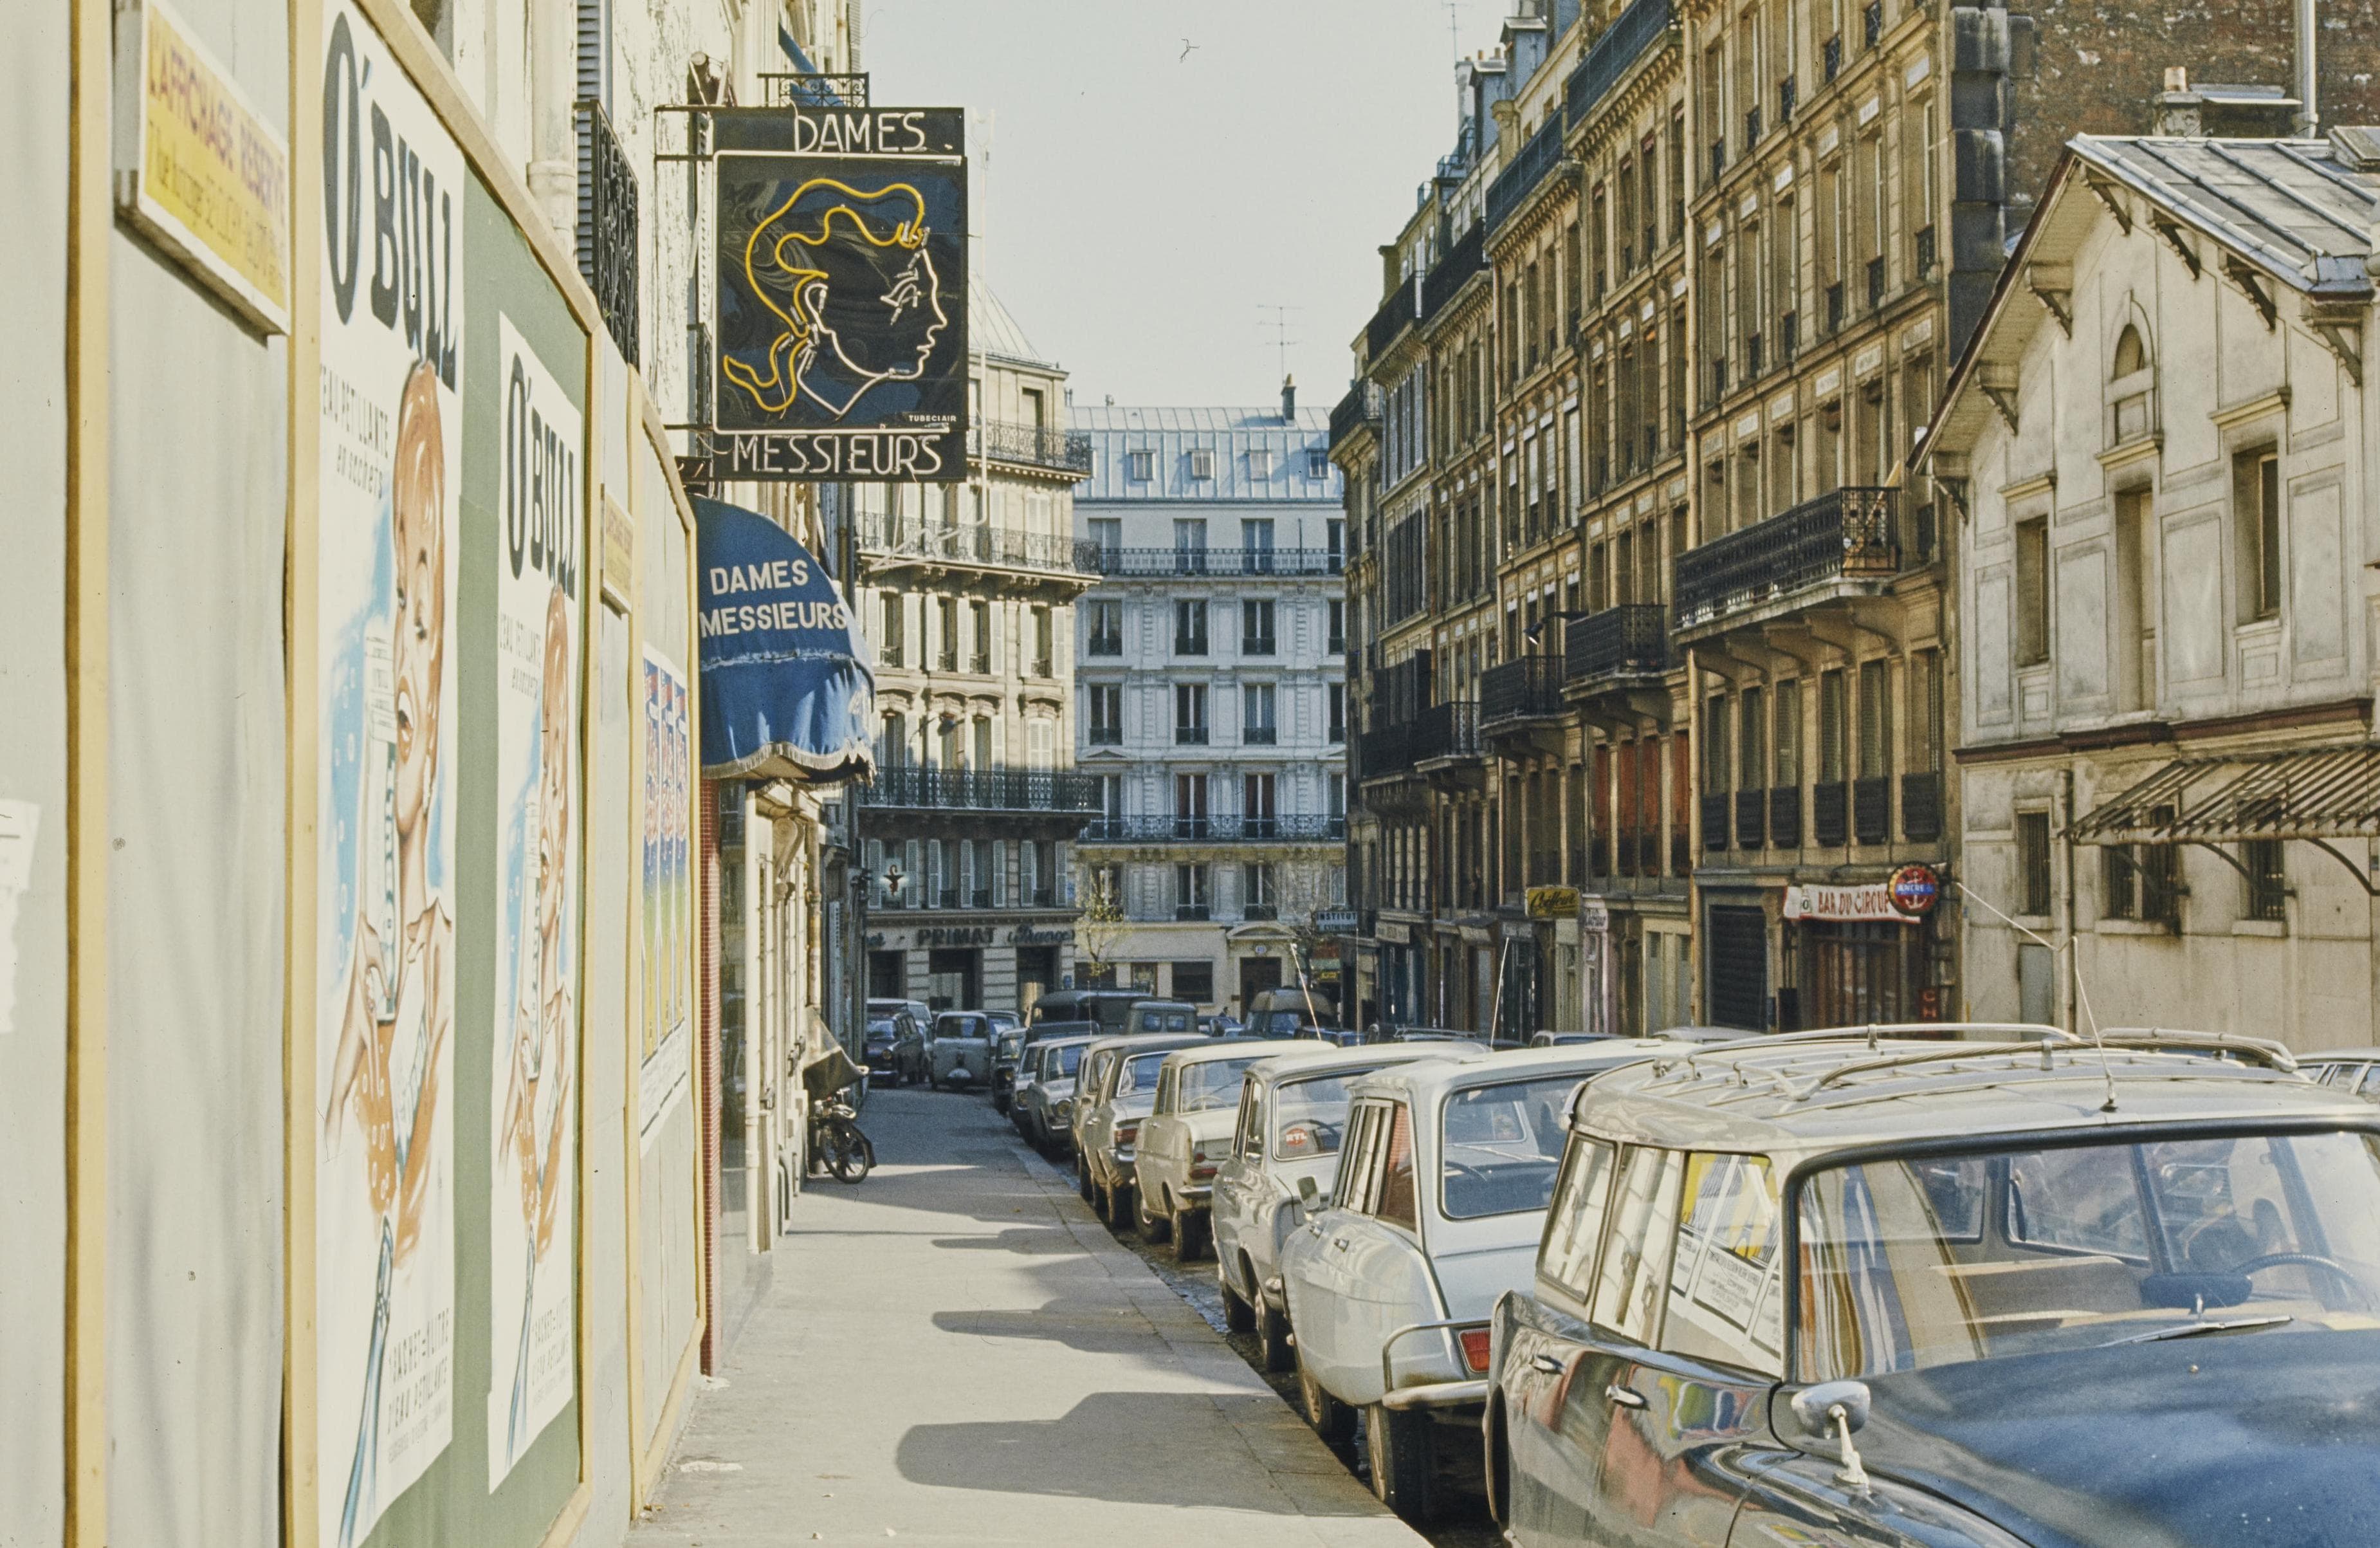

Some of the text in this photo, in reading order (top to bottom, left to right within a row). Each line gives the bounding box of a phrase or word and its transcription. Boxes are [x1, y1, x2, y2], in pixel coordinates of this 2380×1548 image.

[794, 111, 926, 153] DAMES
[324, 11, 457, 393] O'BULL
[733, 434, 942, 475] MESSIEURS
[508, 353, 576, 602] O'BULL
[710, 559, 809, 595] DAMES
[699, 602, 847, 638] MESSIEURS
[1317, 912, 1356, 921] INSTITUT
[1818, 892, 1835, 914] BAR
[1839, 893, 1851, 915] DU
[917, 927, 996, 946] PRIMAT
[1286, 1132, 1306, 1142] RTL
